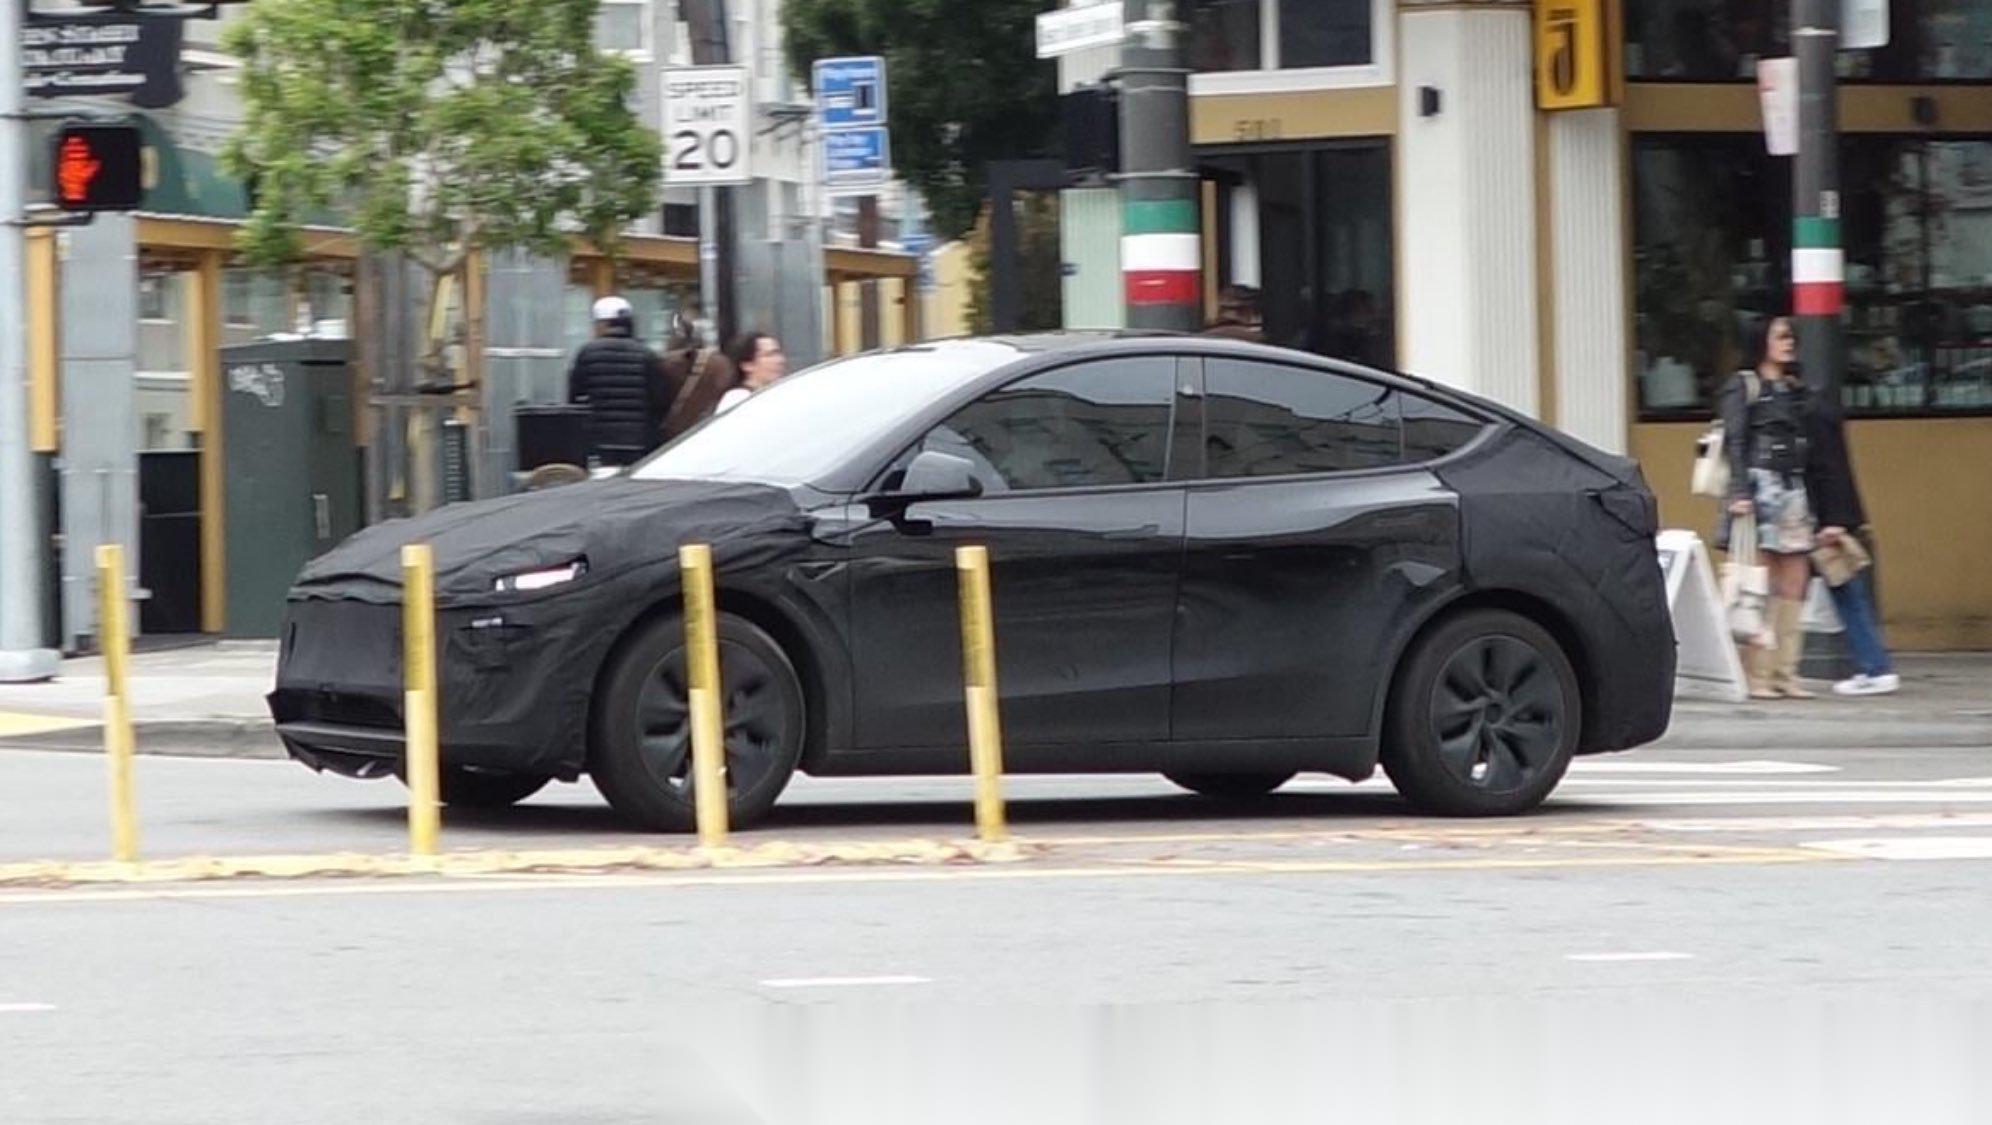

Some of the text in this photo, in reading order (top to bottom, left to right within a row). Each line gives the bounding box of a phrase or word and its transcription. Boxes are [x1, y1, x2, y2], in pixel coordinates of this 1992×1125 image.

[667, 80, 742, 99] SPEED
[674, 103, 736, 123] LIMIT
[674, 128, 739, 170] 20
